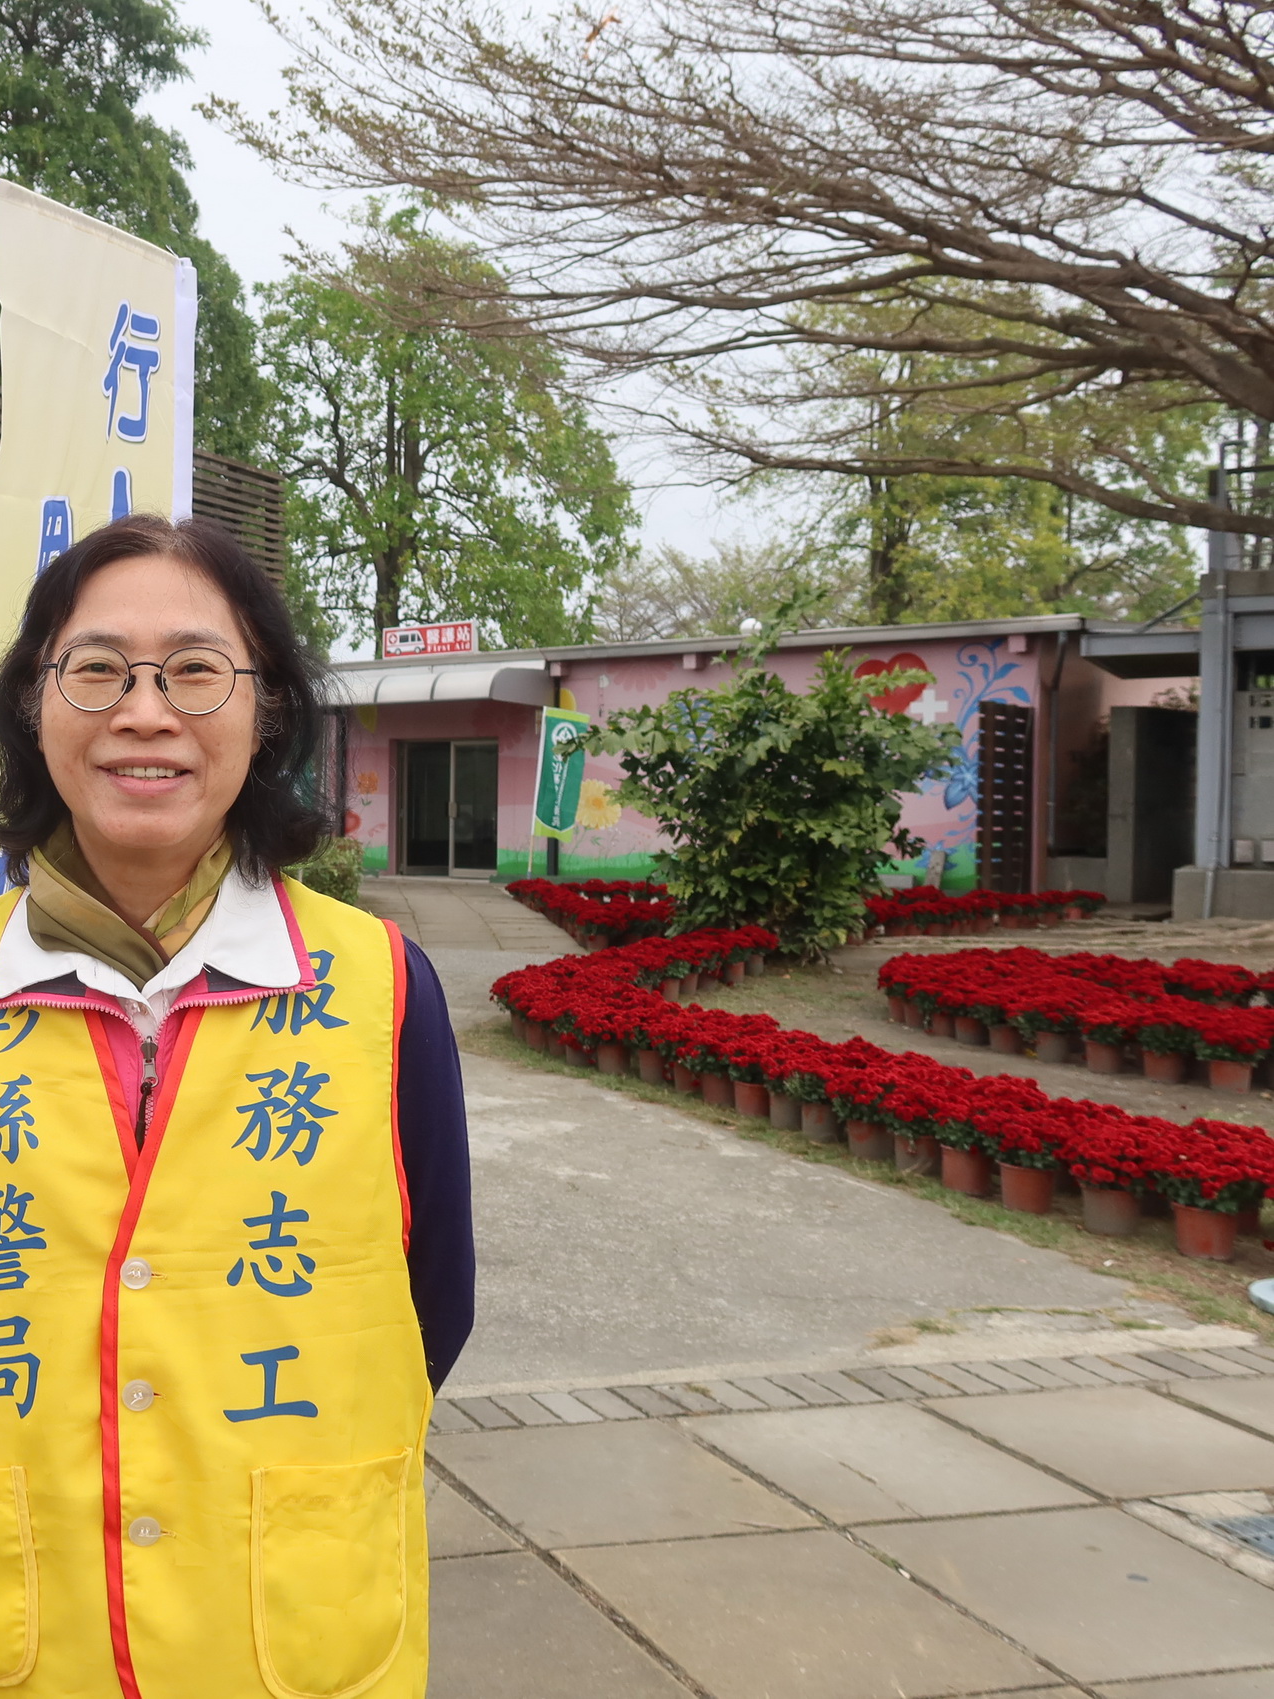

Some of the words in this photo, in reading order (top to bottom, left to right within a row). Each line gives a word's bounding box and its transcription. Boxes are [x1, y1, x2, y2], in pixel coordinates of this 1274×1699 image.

[102, 300, 160, 521] 行
[223, 949, 350, 1424] 服務志工
